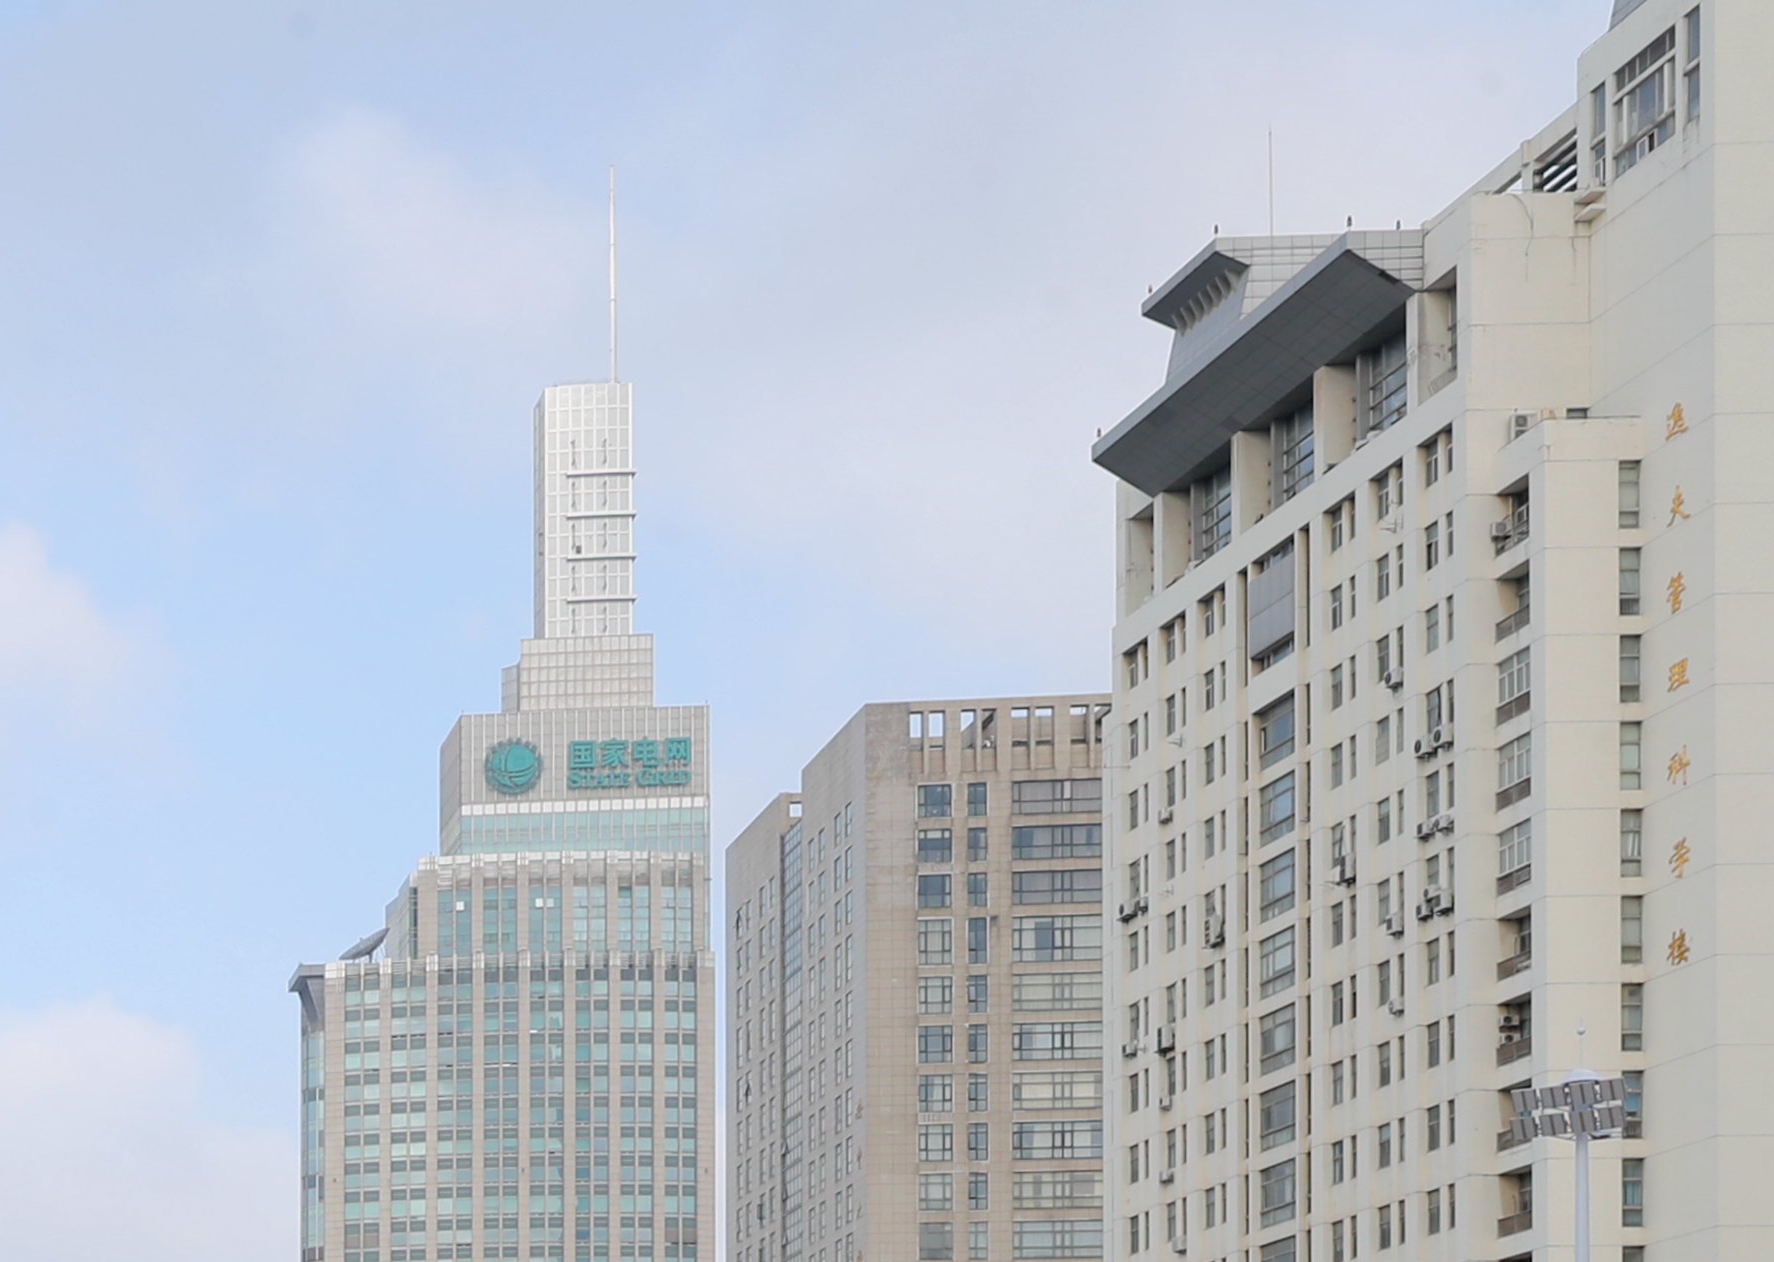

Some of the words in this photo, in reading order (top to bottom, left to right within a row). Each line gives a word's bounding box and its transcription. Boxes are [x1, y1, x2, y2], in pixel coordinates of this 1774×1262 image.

[568, 735, 692, 769] 国家电网
[636, 767, 692, 787] GRID
